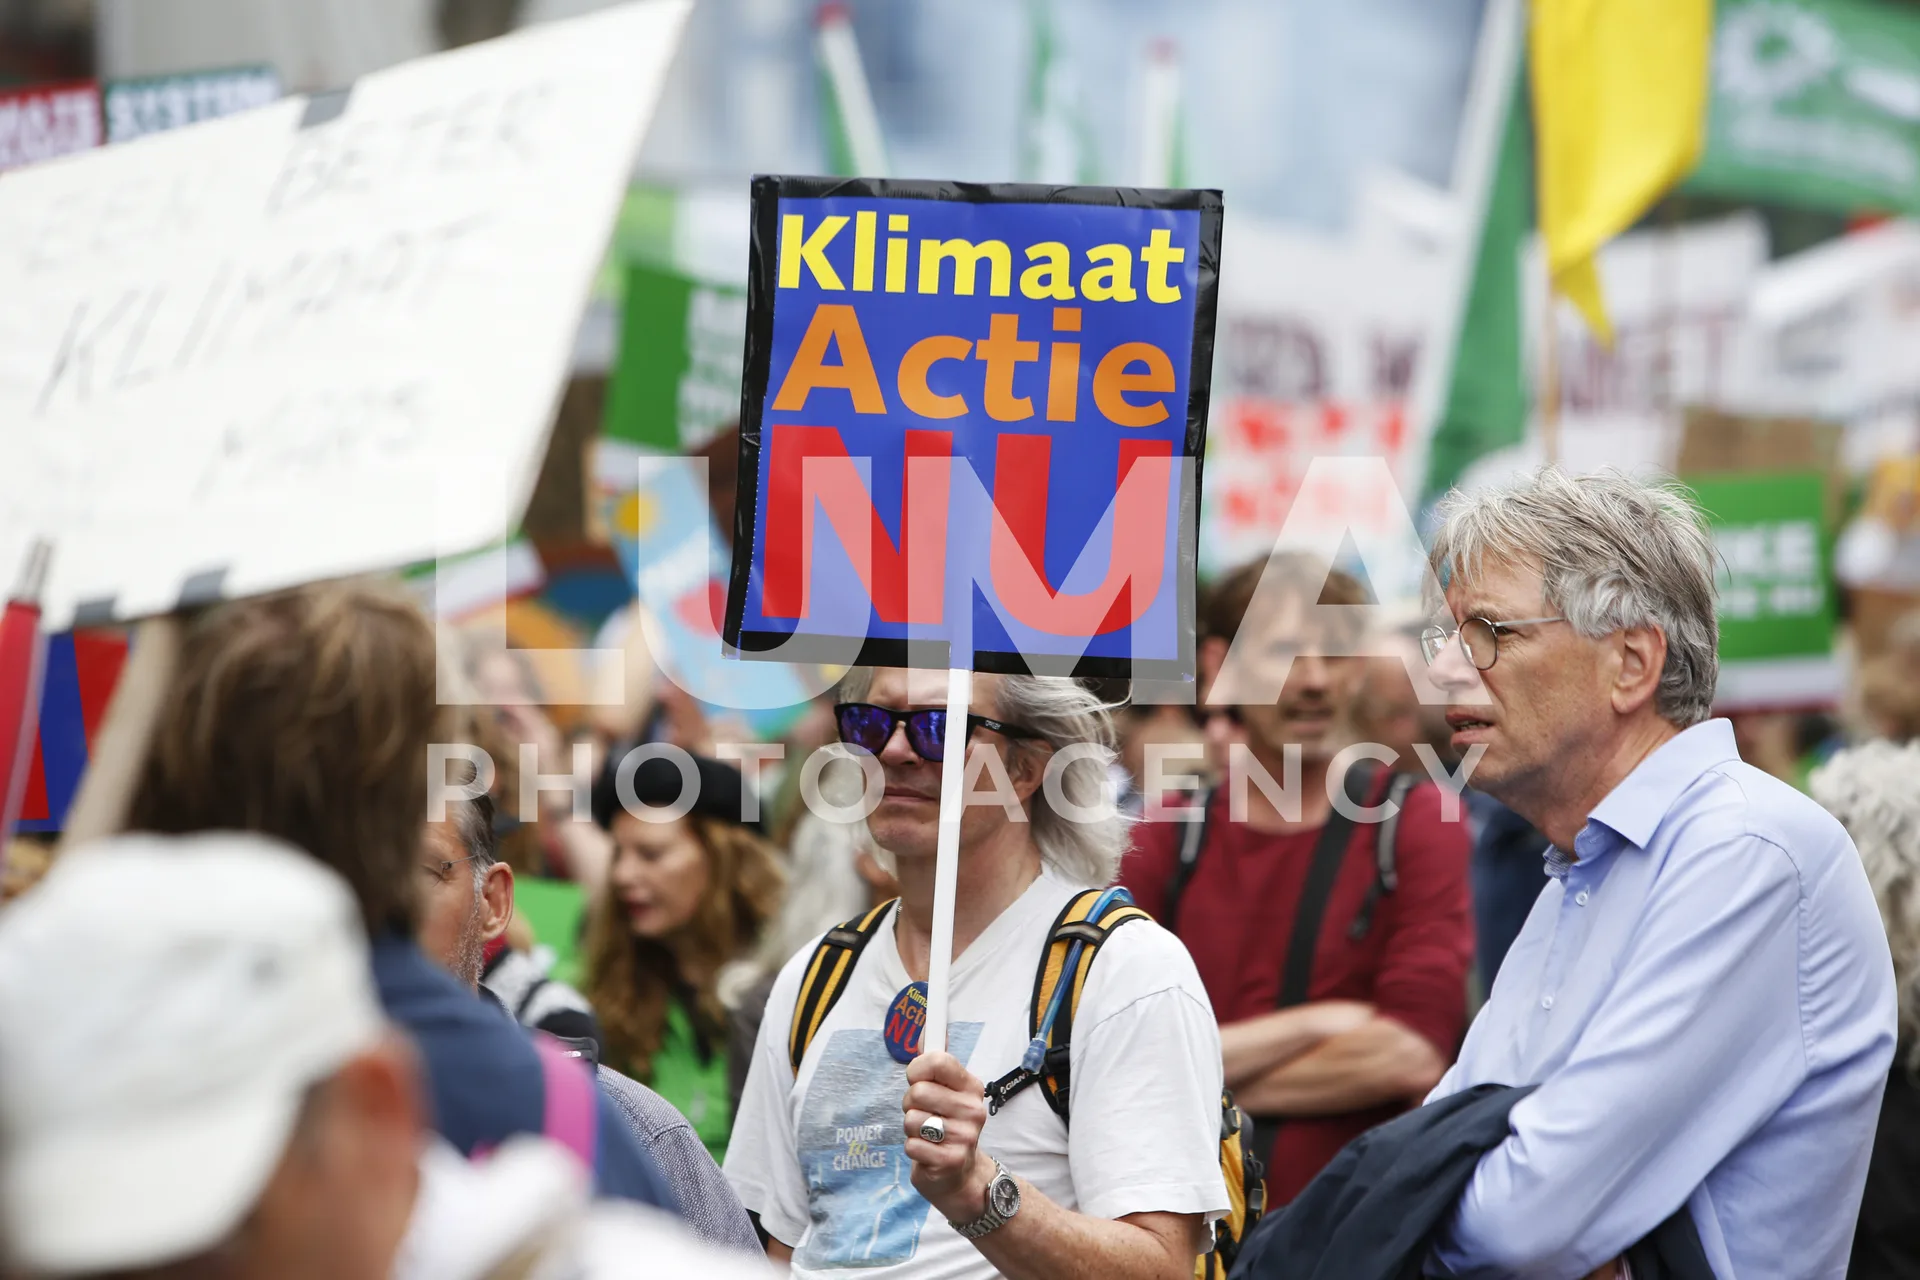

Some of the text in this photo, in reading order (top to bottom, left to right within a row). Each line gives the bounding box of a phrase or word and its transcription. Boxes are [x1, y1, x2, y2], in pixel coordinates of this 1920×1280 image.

[777, 211, 1186, 304] Klimaat
[771, 304, 1176, 428] Actie
[761, 424, 1173, 637] NU
[894, 995, 927, 1027] Acti
[906, 986, 929, 1009] Klima
[885, 1011, 919, 1054] NU
[835, 1124, 883, 1144] POWER
[848, 1140, 868, 1156] to
[832, 1151, 887, 1171] CHANGE
